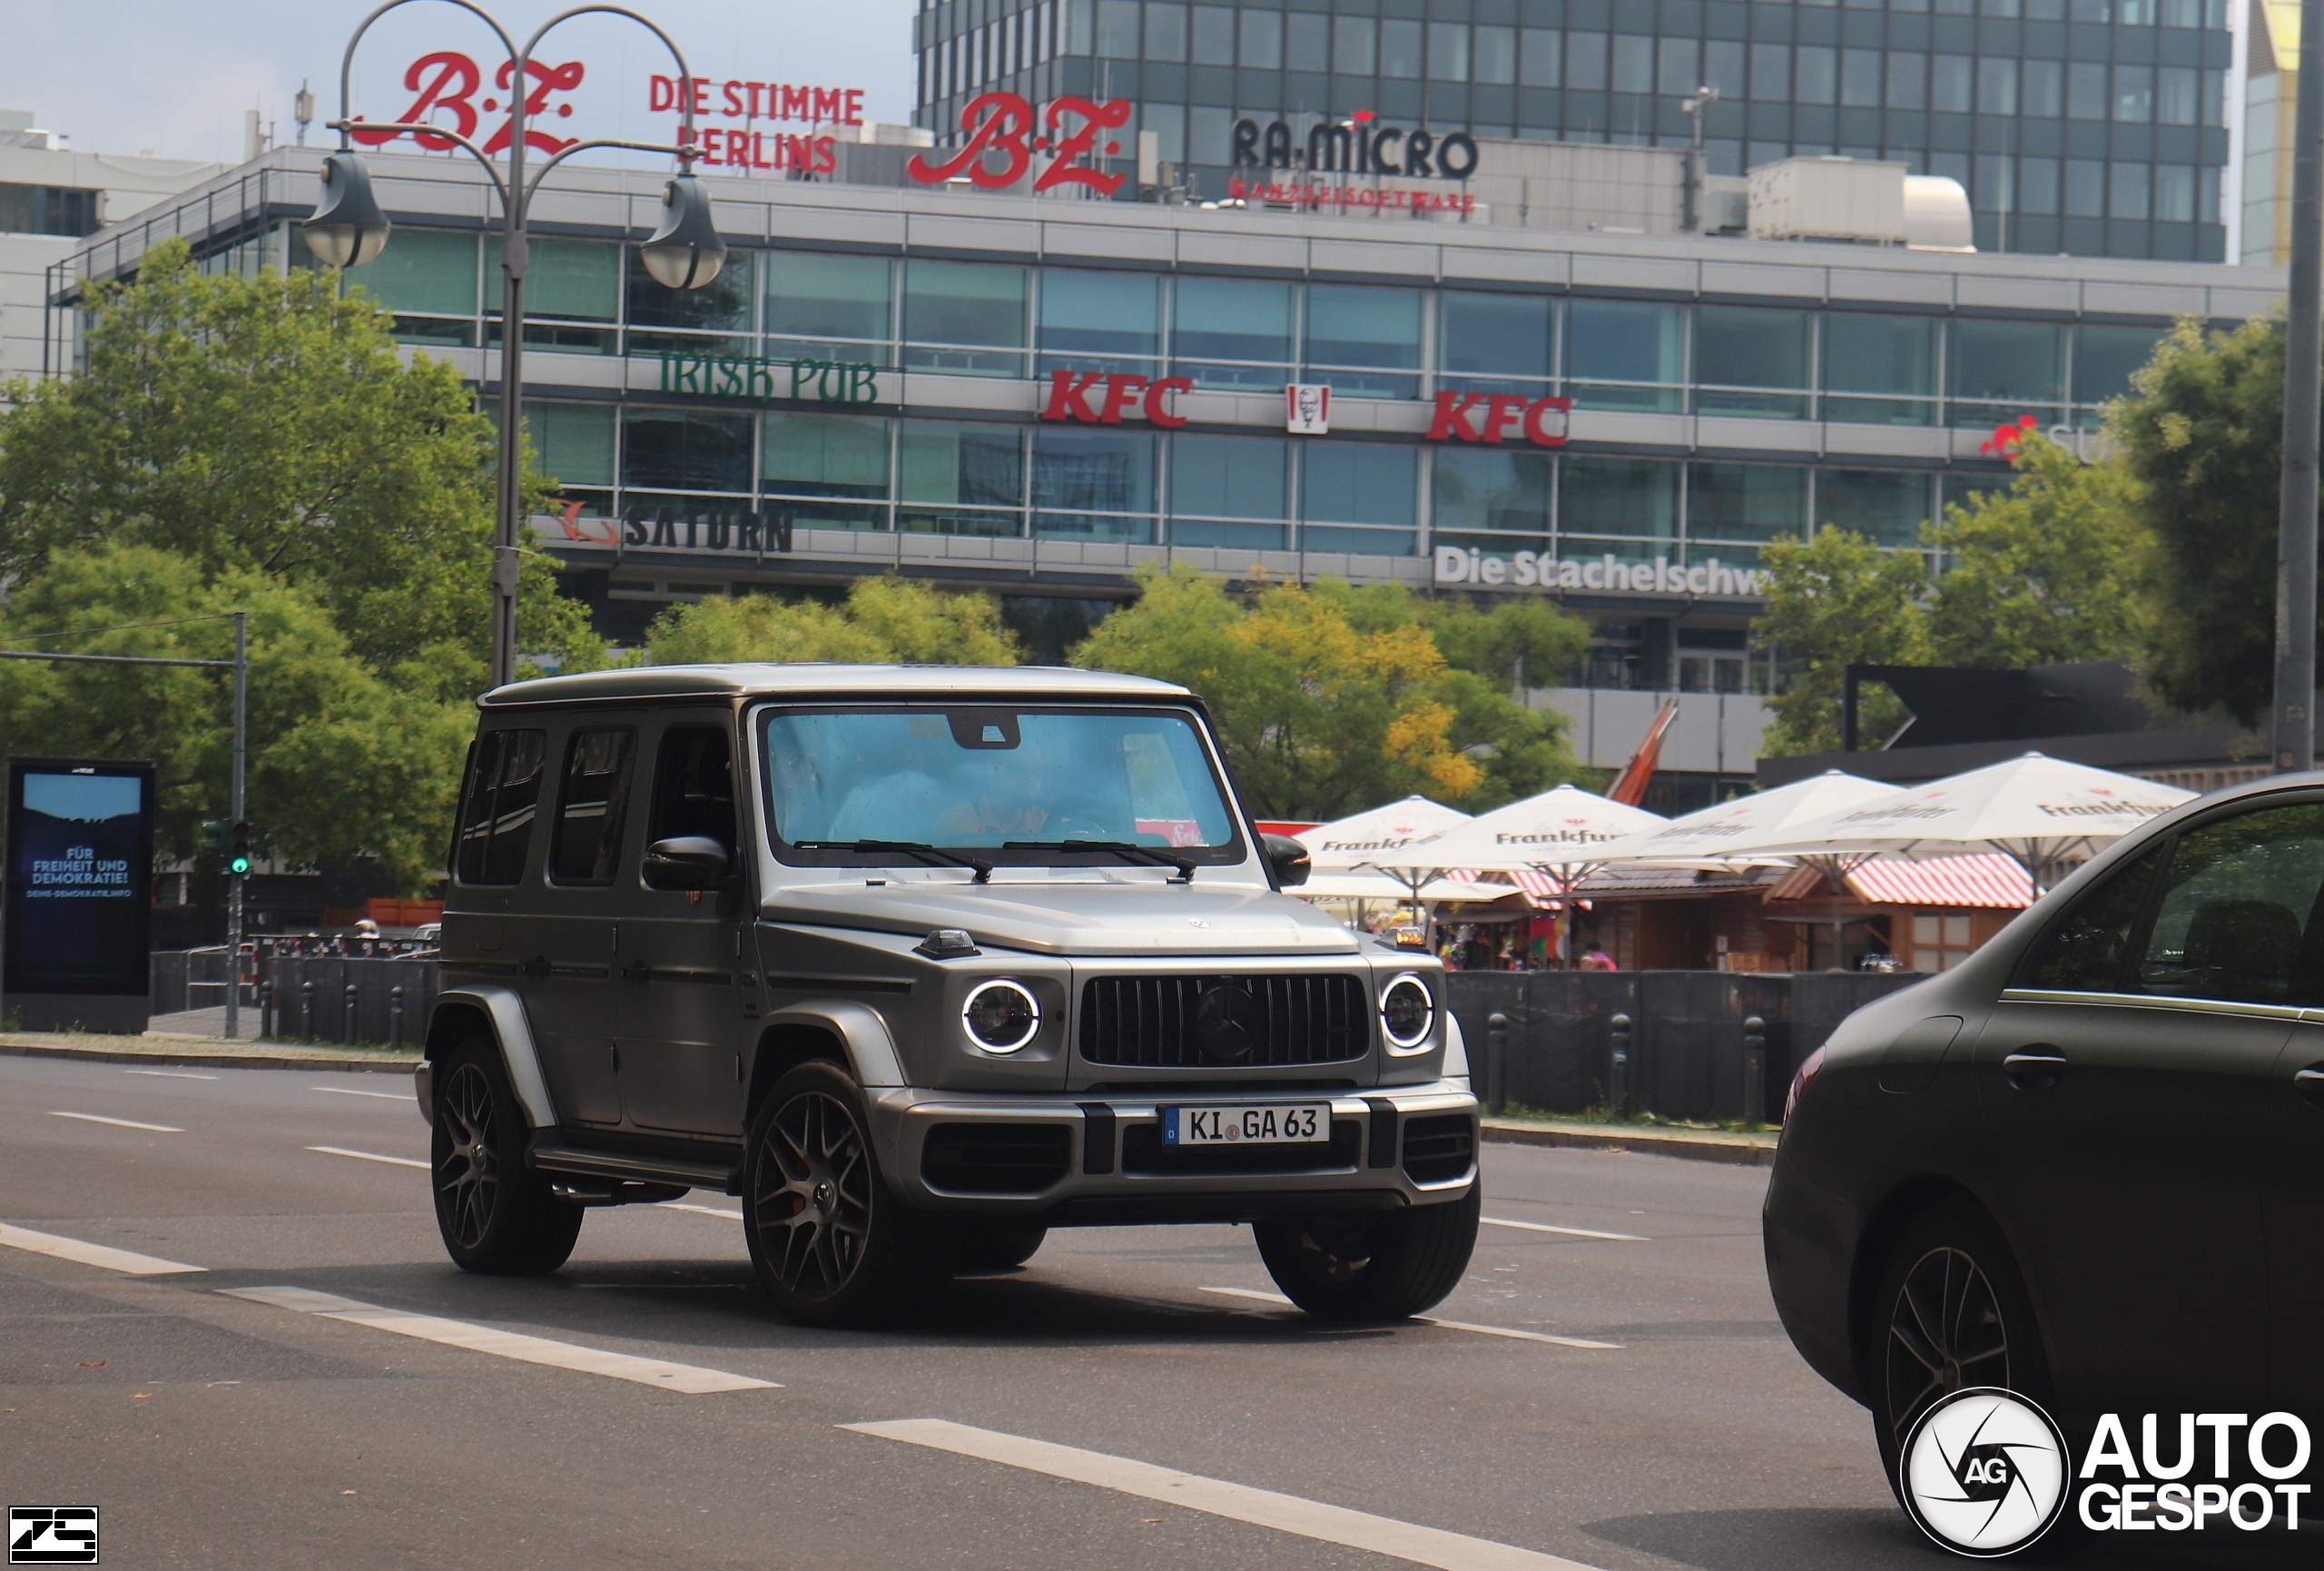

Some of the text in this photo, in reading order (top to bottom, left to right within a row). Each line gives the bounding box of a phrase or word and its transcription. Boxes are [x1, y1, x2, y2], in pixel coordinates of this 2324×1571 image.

[650, 74, 864, 126] DIE STIMME
[677, 126, 836, 173] BERLINS
[1229, 175, 1475, 213] KANZLEISOFTWARE
[661, 351, 878, 403] IRISH PUB
[1039, 370, 1192, 428] KFC
[1424, 390, 1571, 447] KFC
[625, 506, 793, 553] SATURN
[1433, 545, 1827, 597] Die Stachelschw
[33, 861, 127, 873] FREIHEIT UND
[67, 846, 94, 860] FÜR
[32, 873, 128, 884] DEMOKRATIE!
[1190, 1109, 1317, 1140] KI GA 63
